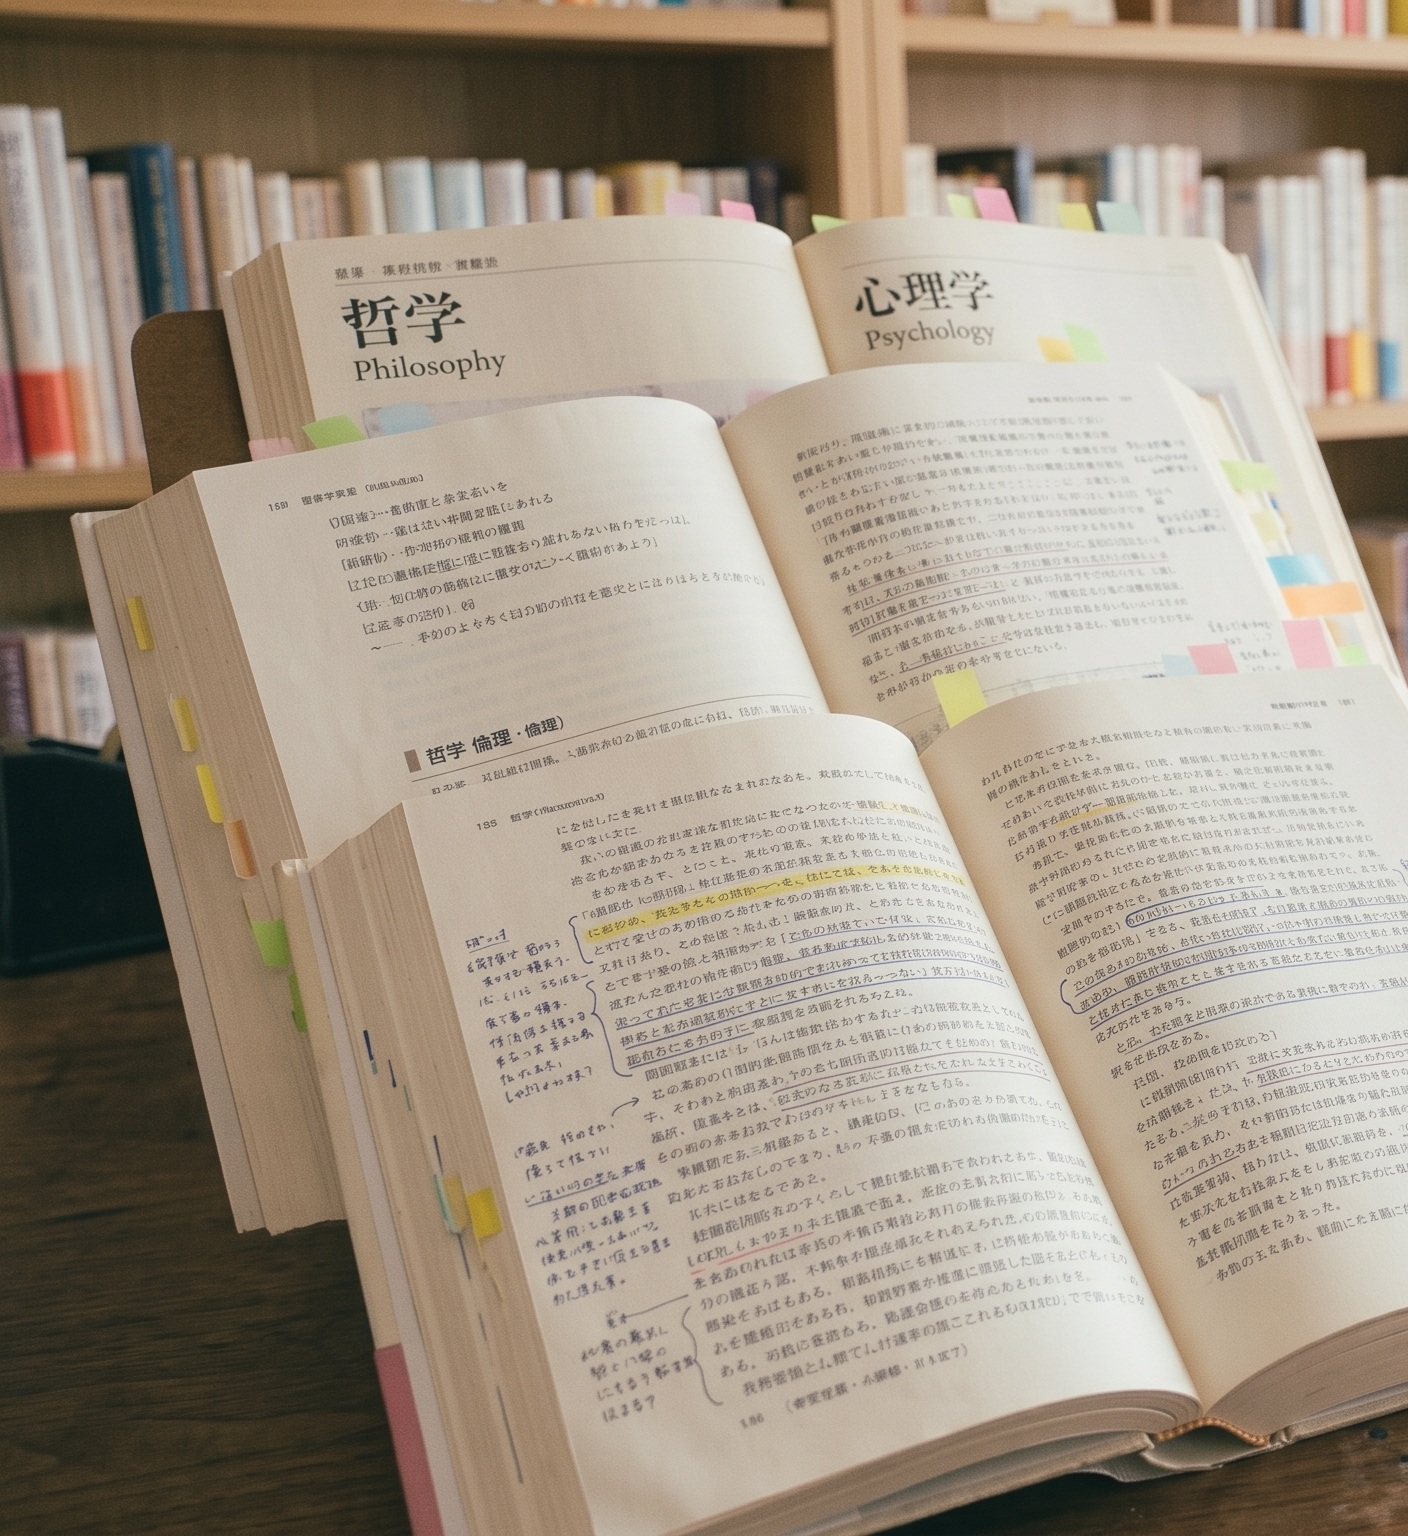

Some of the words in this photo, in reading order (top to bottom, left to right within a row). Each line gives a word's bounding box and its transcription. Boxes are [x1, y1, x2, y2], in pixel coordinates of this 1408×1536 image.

[855, 270, 994, 318] 心理学
[341, 291, 466, 349] 哲学
[864, 319, 995, 351] Psychology
[353, 349, 506, 381] Philosophy
[425, 741, 467, 766] 哲学
